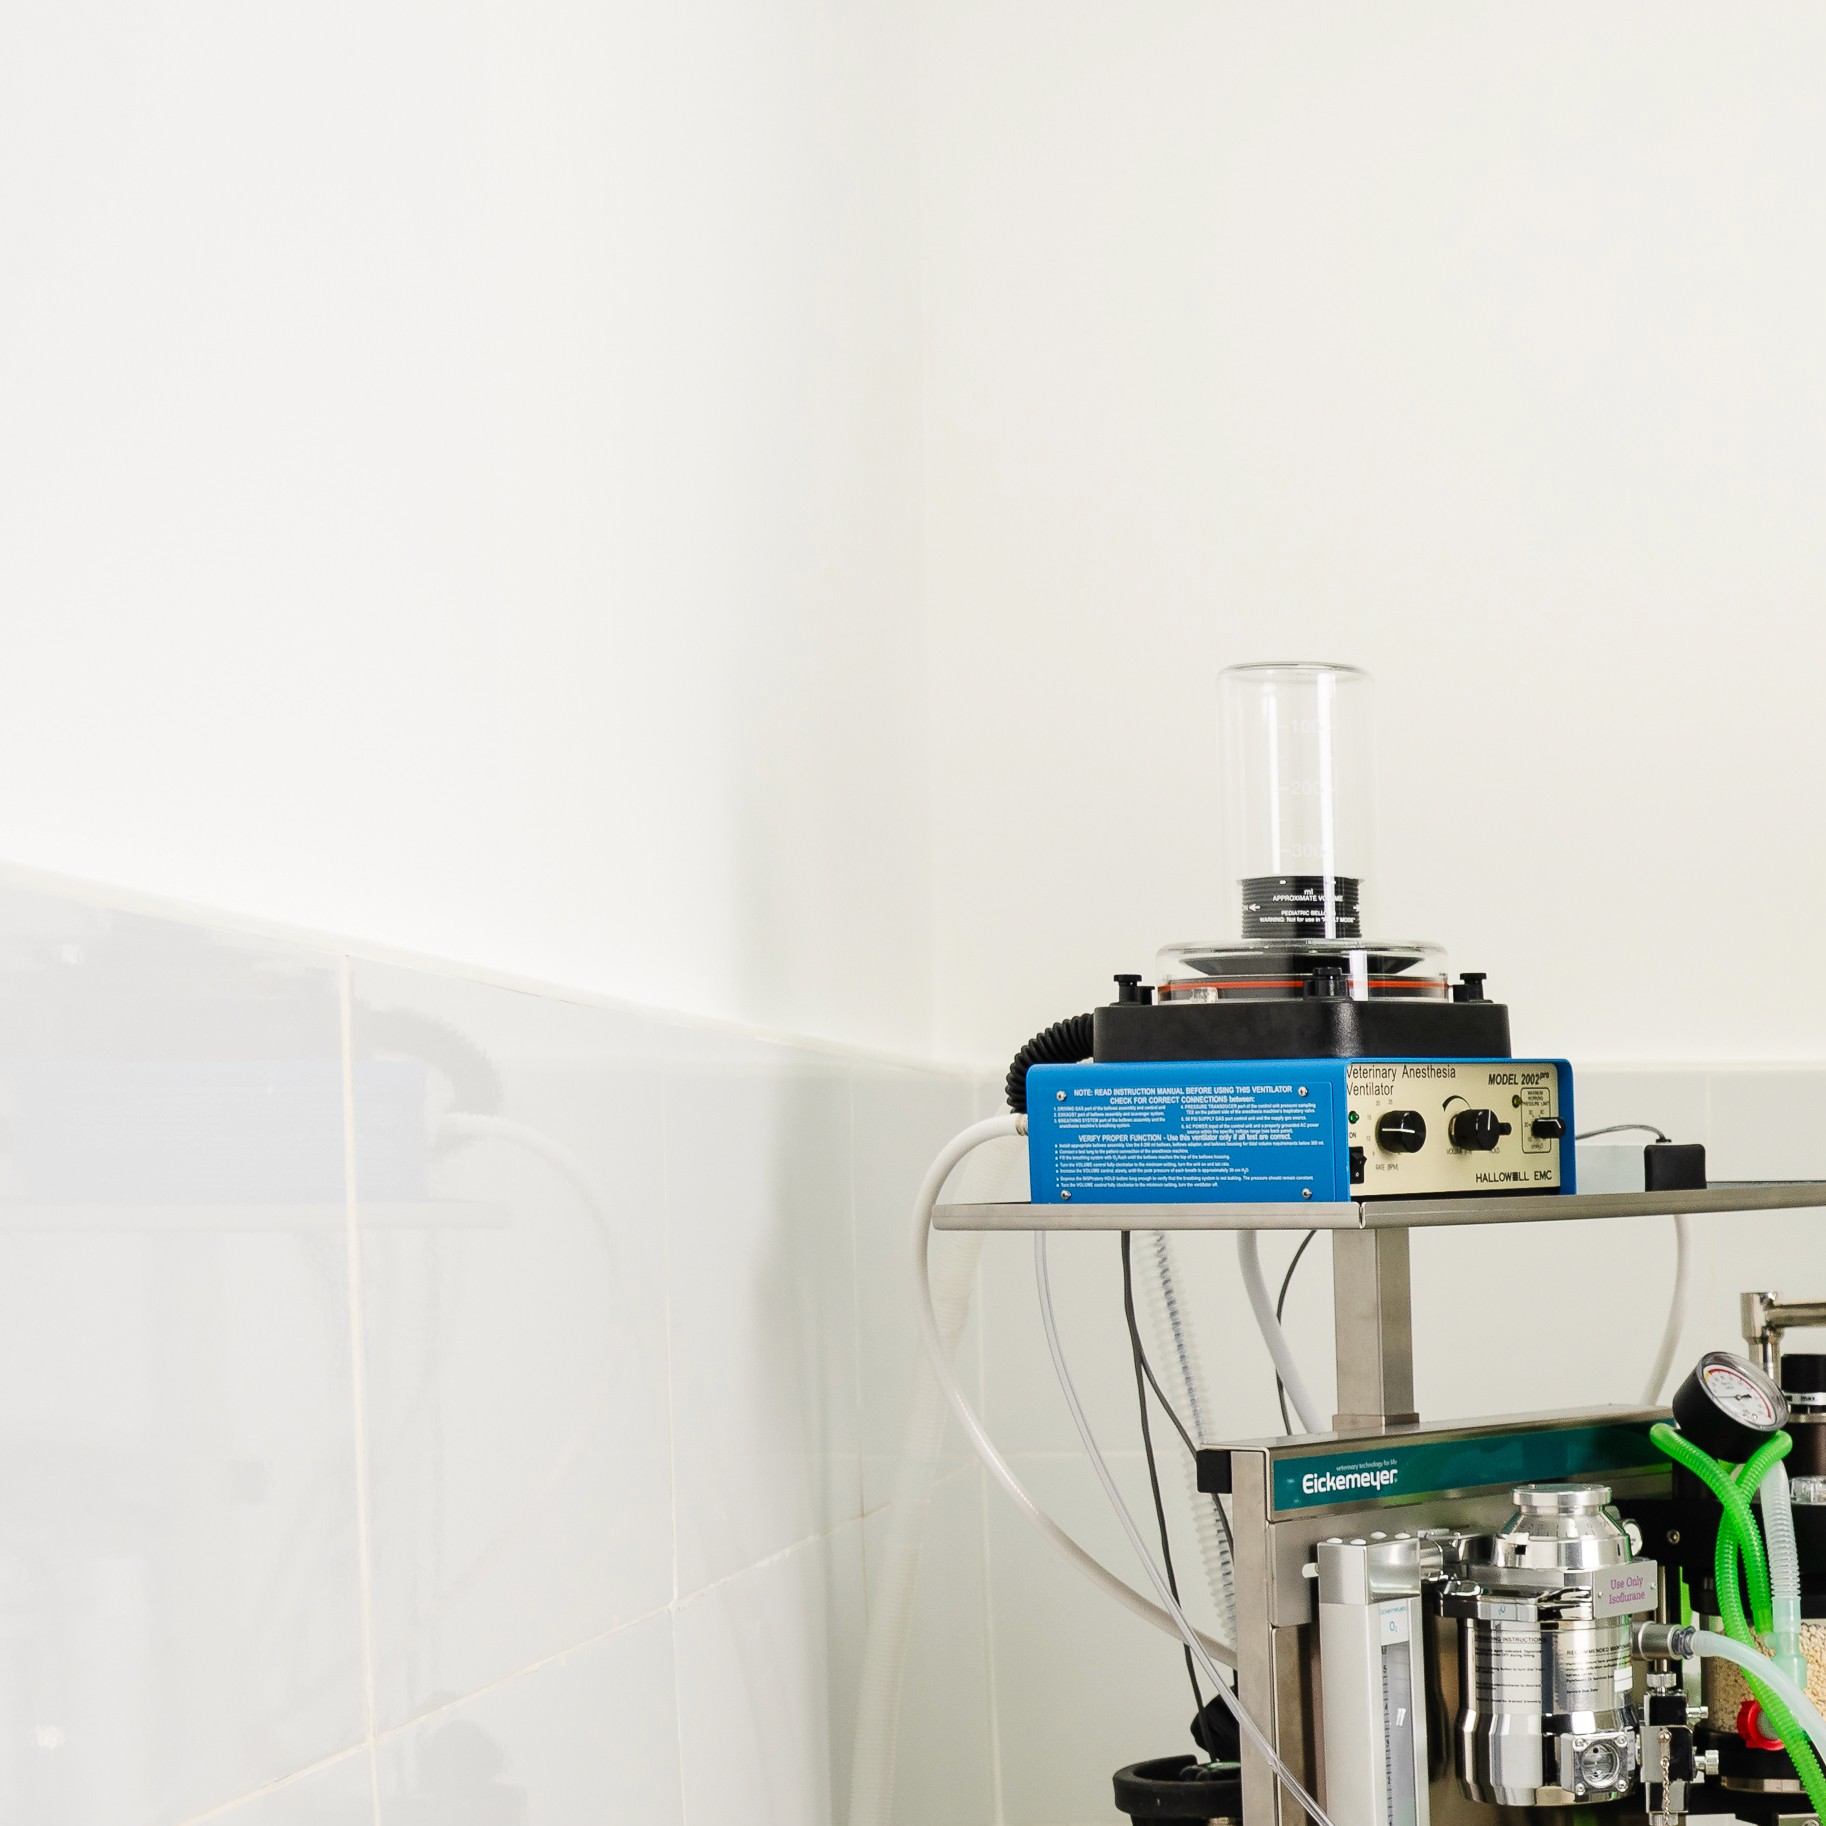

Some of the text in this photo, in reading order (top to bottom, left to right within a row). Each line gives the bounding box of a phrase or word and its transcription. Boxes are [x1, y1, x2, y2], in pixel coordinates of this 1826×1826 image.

[1347, 1064, 1456, 1082] Veterinary Anesthesia
[1488, 1074, 1518, 1085] MODEL
[1095, 1088, 1112, 1096] READ
[1214, 1086, 1234, 1094] USING
[1347, 1082, 1394, 1096] Ventilator
[1110, 1097, 1132, 1105] CHECK
[1102, 1134, 1128, 1142] PROPER
[1219, 1134, 1232, 1142] only
[1534, 1170, 1552, 1180] EMC
[1302, 1469, 1398, 1494] Eickemeyer
[1610, 1576, 1643, 1590] Use Only
[1609, 1591, 1646, 1605] Isoflurane
